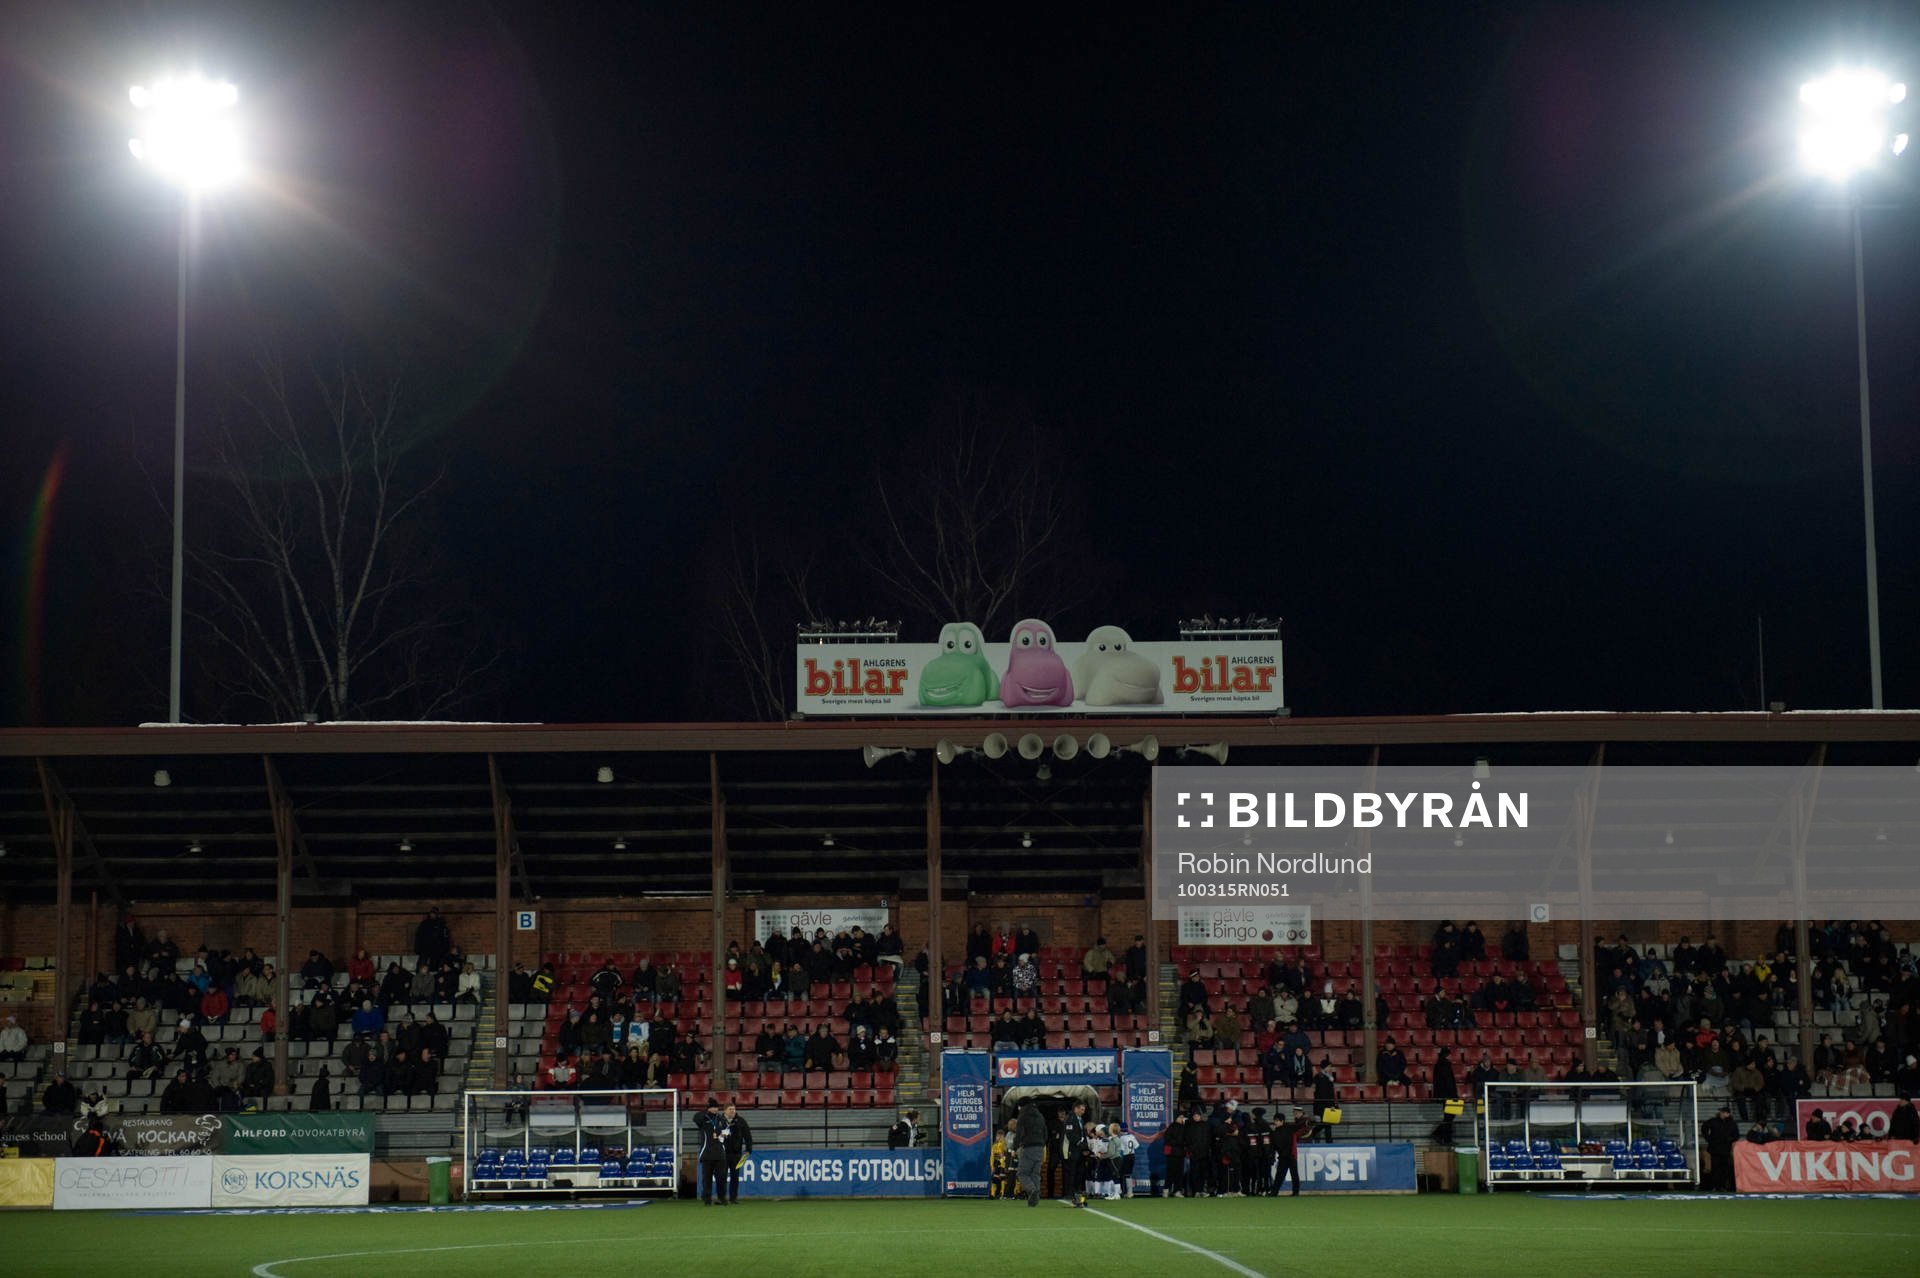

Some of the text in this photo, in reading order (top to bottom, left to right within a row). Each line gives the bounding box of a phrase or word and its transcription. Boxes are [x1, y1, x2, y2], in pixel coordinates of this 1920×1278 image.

[863, 659, 906, 667] AHLGRENS
[1231, 656, 1275, 664] AHLGRENS
[804, 658, 908, 696] bilar
[1172, 655, 1276, 693] bilar
[520, 913, 532, 928] B
[790, 912, 832, 926] gävle
[1213, 909, 1255, 925] gävle
[1533, 906, 1546, 921] C
[1213, 923, 1258, 942] bingo
[1022, 1059, 1114, 1075] STRYKTIPSET
[122, 1118, 173, 1127] RESTAURANG
[32, 1131, 67, 1141] School
[136, 1130, 196, 1144] KOCKAR
[233, 1127, 366, 1138] AHLFORD ADVOKATBYRÅ
[760, 1159, 844, 1182] SVERIGES
[1757, 1150, 1915, 1181] VIKING
[59, 1167, 190, 1189] CESAROTTI
[255, 1167, 360, 1189] KORSNÄS
